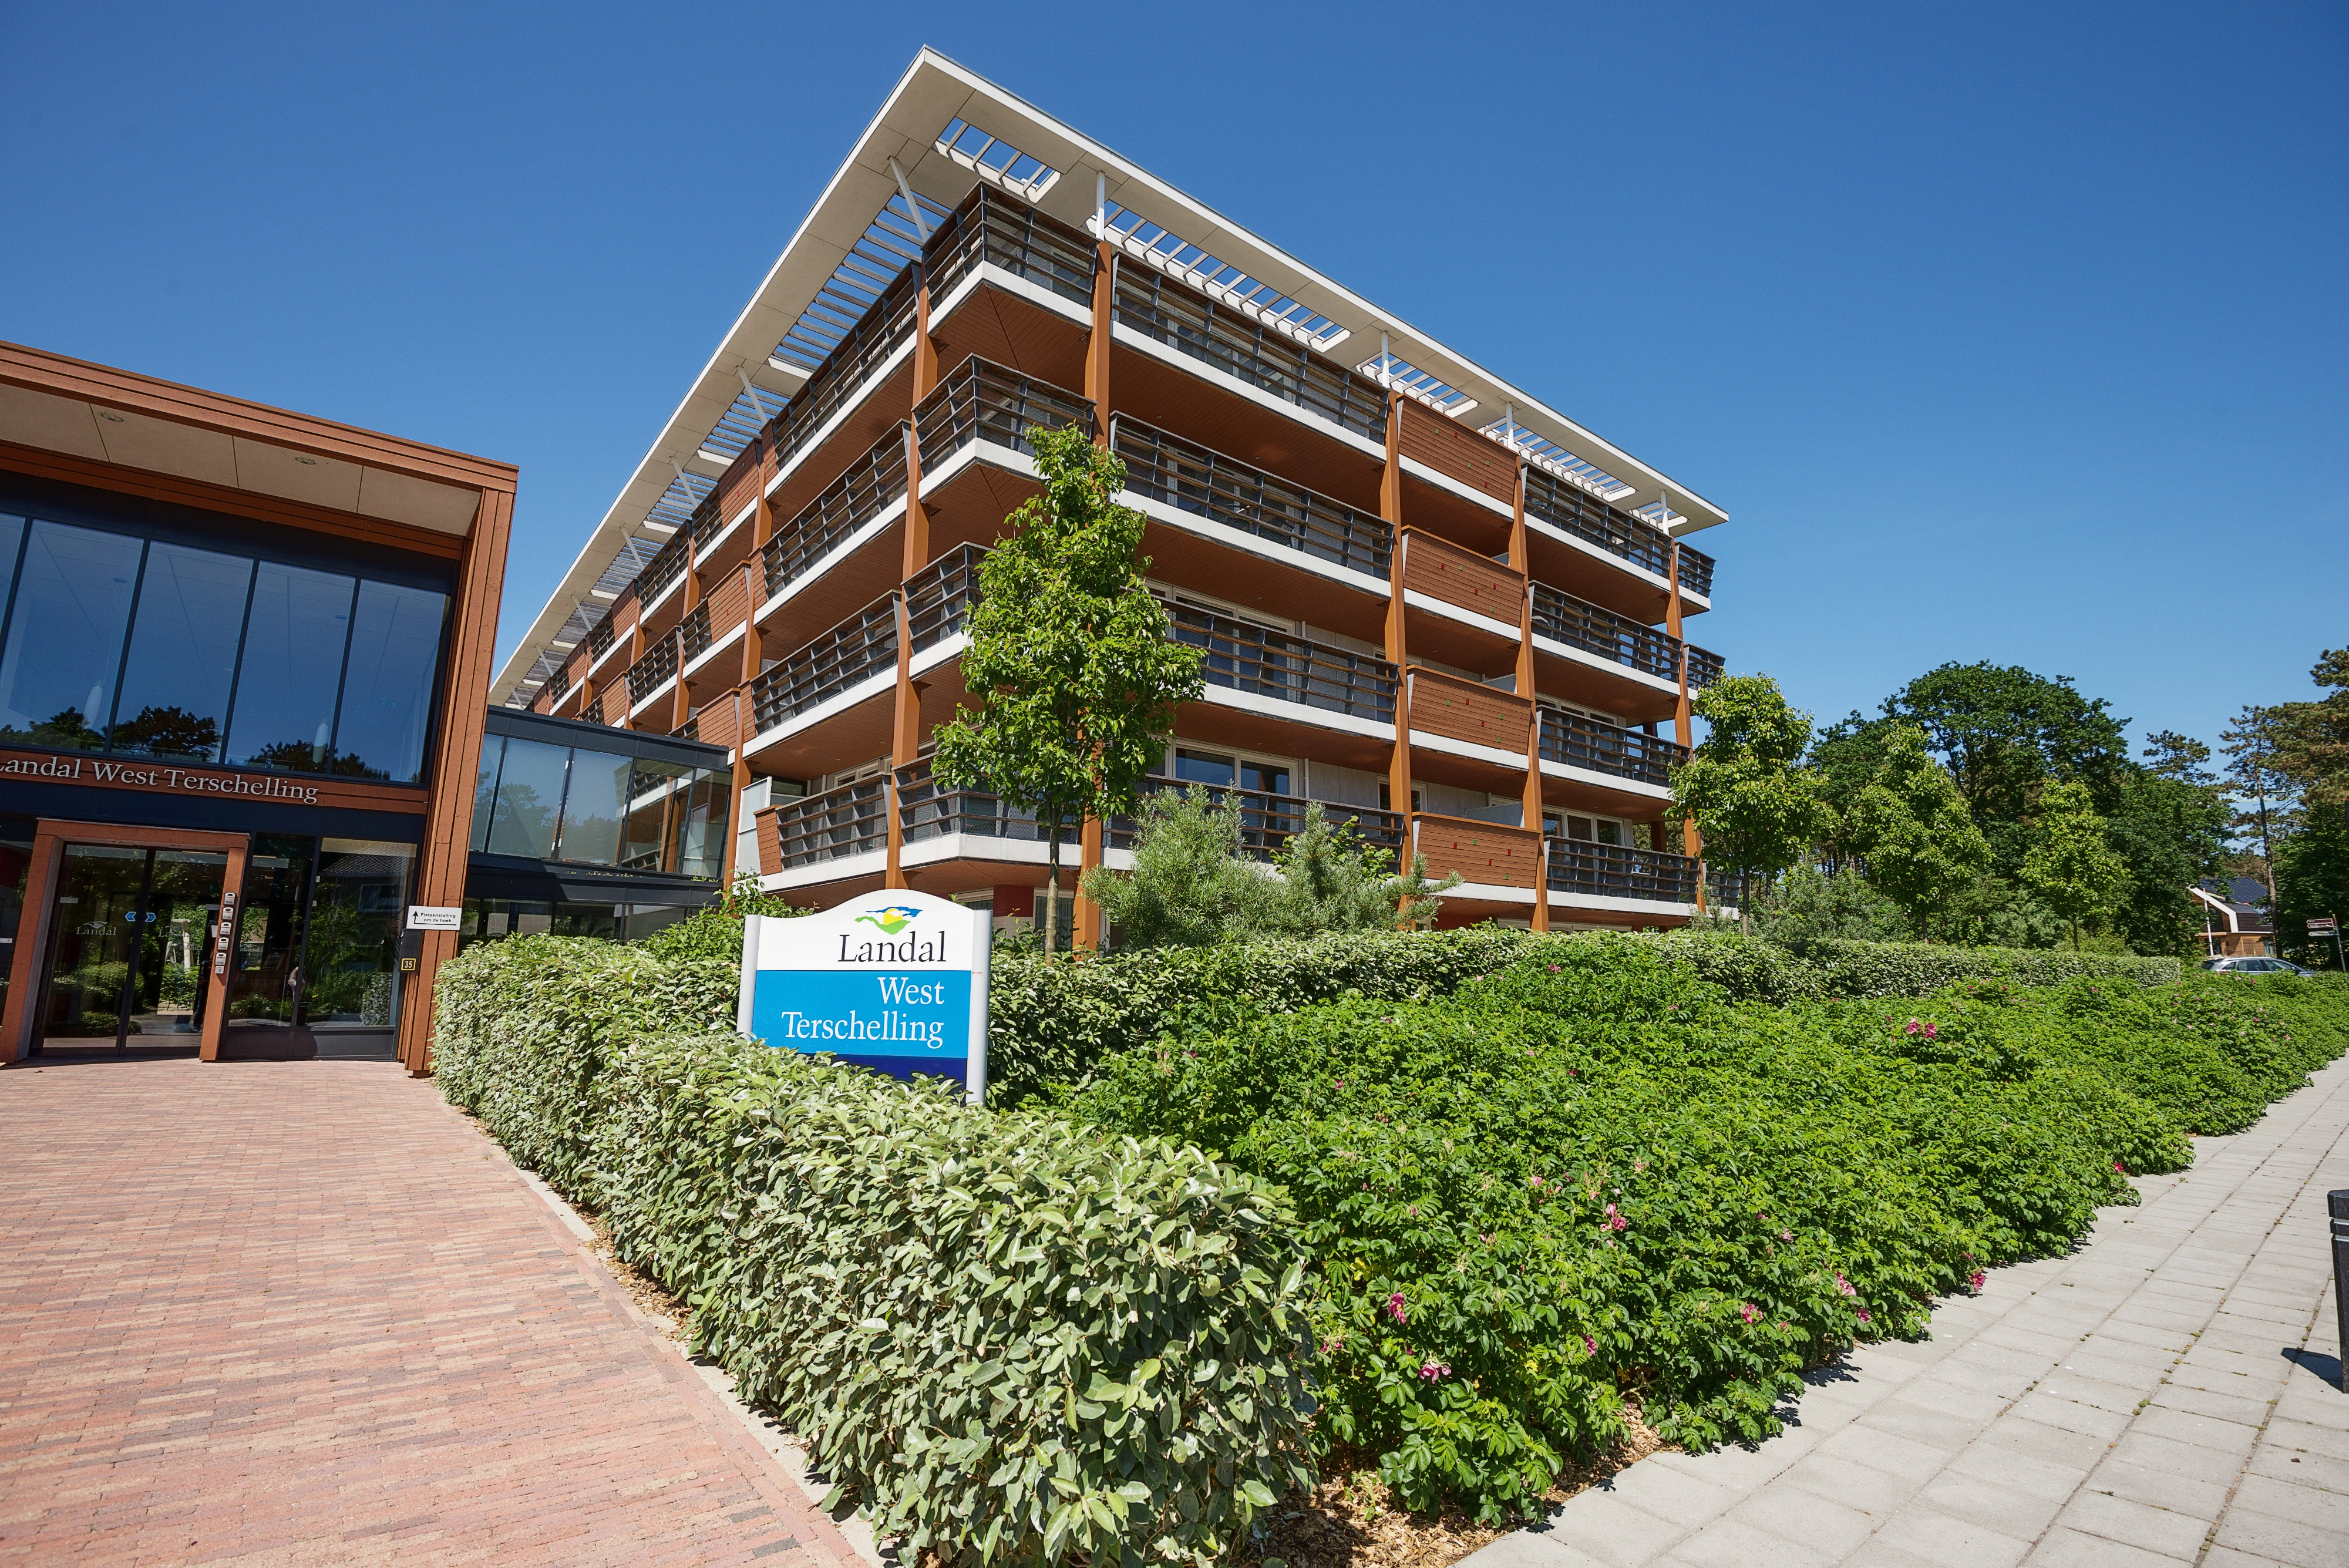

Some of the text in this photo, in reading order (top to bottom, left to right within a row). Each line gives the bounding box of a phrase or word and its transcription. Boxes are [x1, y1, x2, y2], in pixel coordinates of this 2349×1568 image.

[0, 756, 318, 805] andal West Terschelling
[76, 927, 116, 936] Landal
[837, 930, 947, 962] Landal
[404, 960, 412, 968] 35
[877, 977, 945, 1005] West
[781, 1010, 944, 1049] Terschelling
